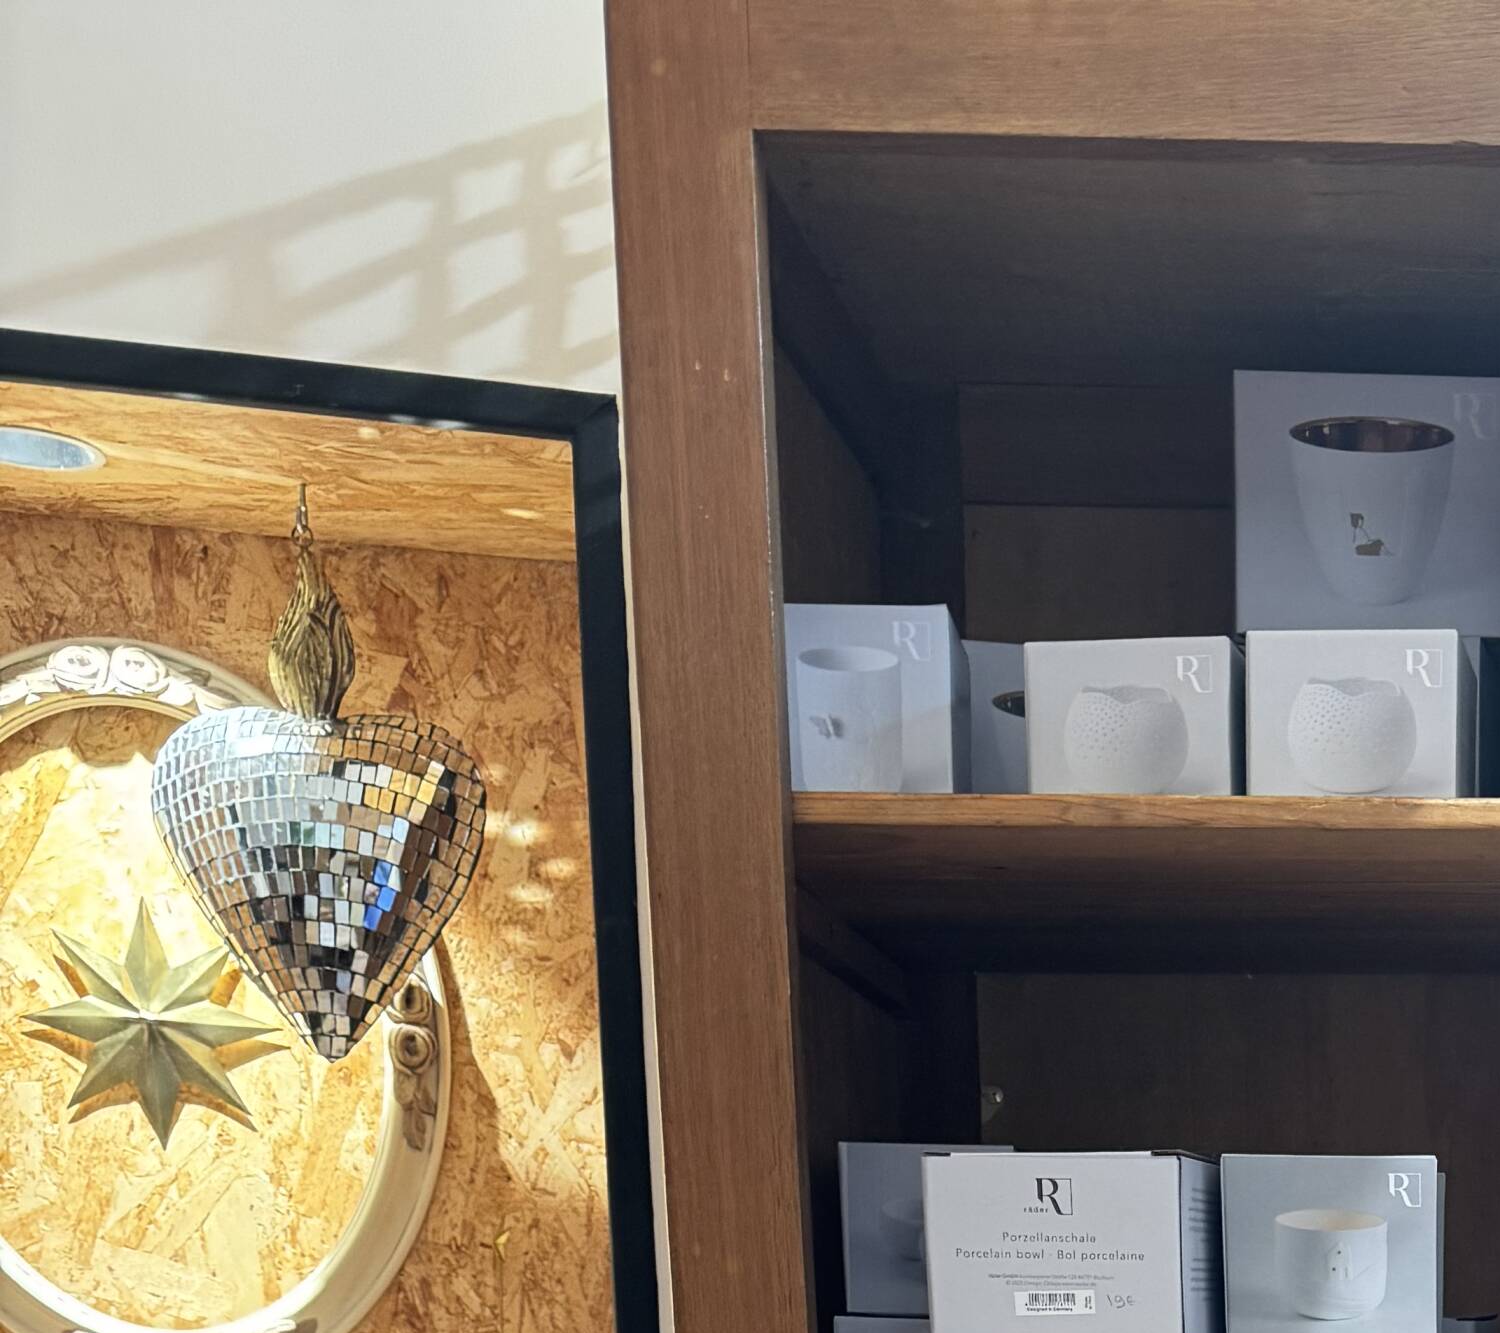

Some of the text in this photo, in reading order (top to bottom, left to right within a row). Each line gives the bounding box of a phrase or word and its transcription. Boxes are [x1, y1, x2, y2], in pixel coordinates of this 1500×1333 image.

[892, 621, 922, 661] R
[1176, 655, 1204, 693] R
[1405, 649, 1432, 687] R
[1035, 1177, 1064, 1216] R
[1388, 1172, 1412, 1208] R
[955, 1248, 1145, 1263] Porcelain bowl Bol porcelaine
[1002, 1231, 1097, 1243] Porzellanschale
